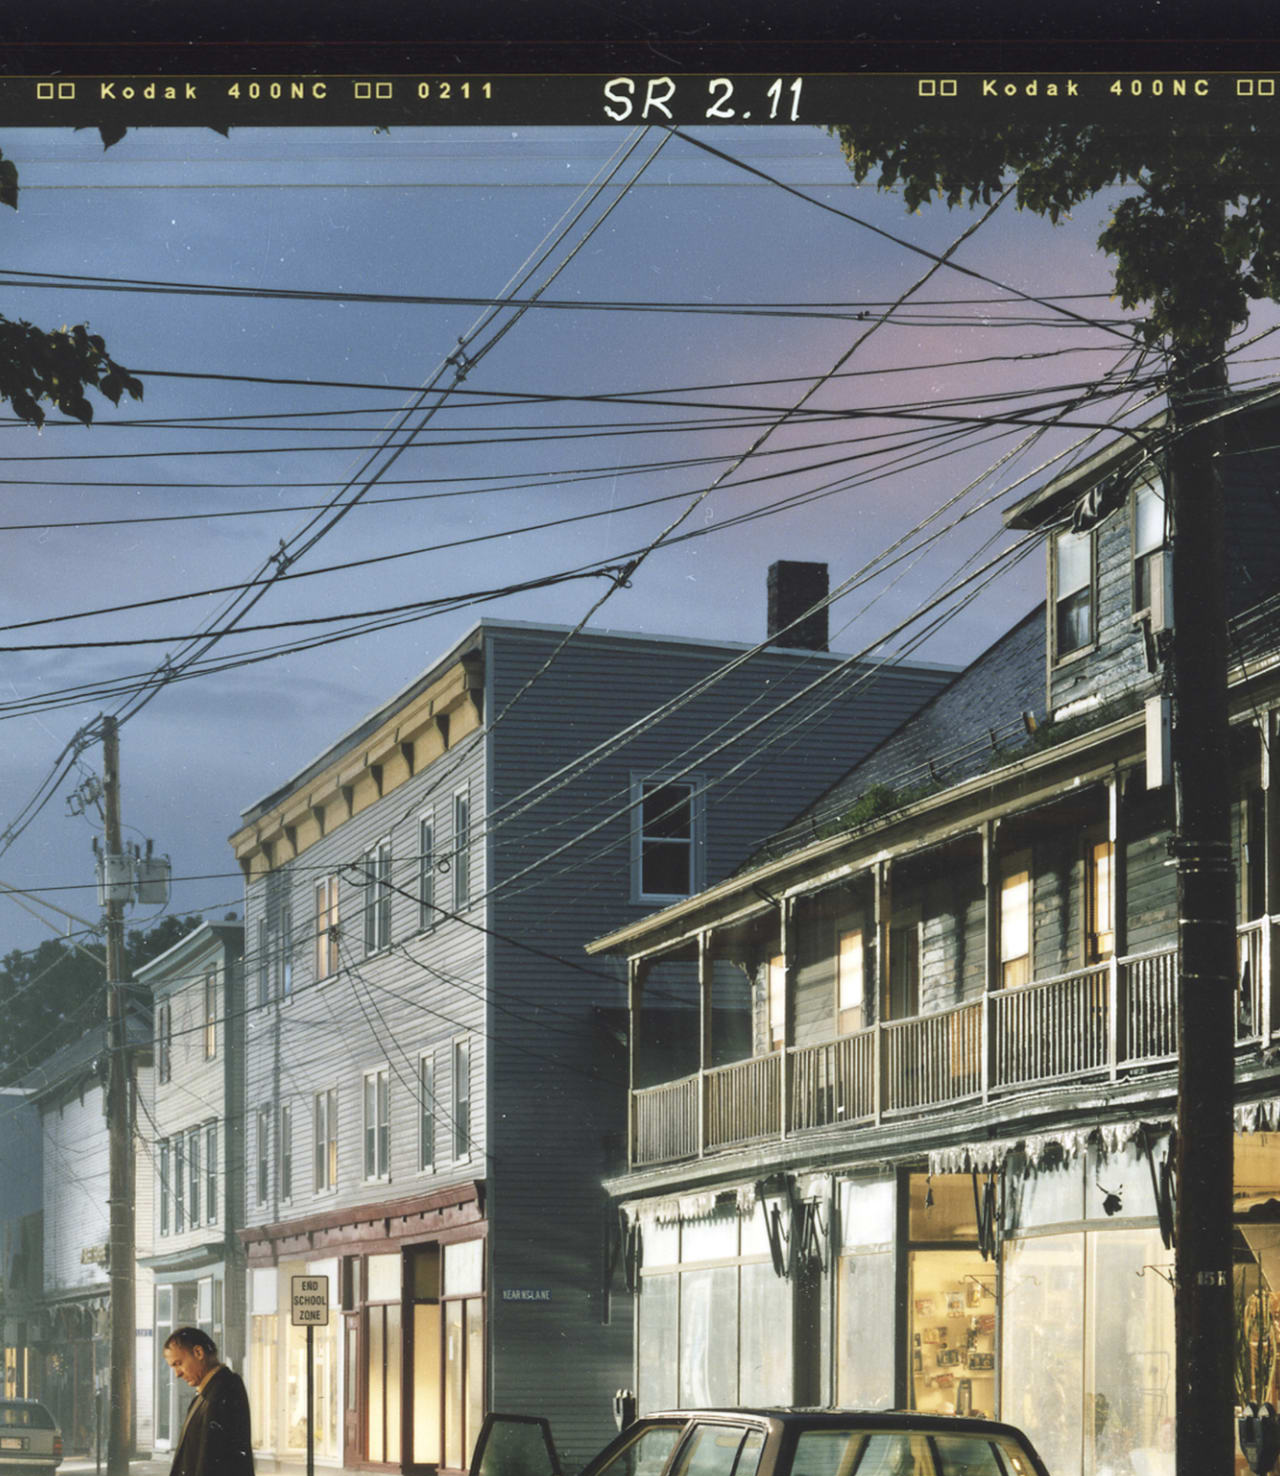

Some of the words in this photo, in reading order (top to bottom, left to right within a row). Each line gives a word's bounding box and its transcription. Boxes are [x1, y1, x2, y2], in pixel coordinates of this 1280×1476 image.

[603, 76, 676, 122] SR
[705, 77, 803, 122] 2.11
[302, 1281, 319, 1291] END
[293, 1295, 327, 1306] SCHOOL
[299, 1310, 321, 1321] ZONE
